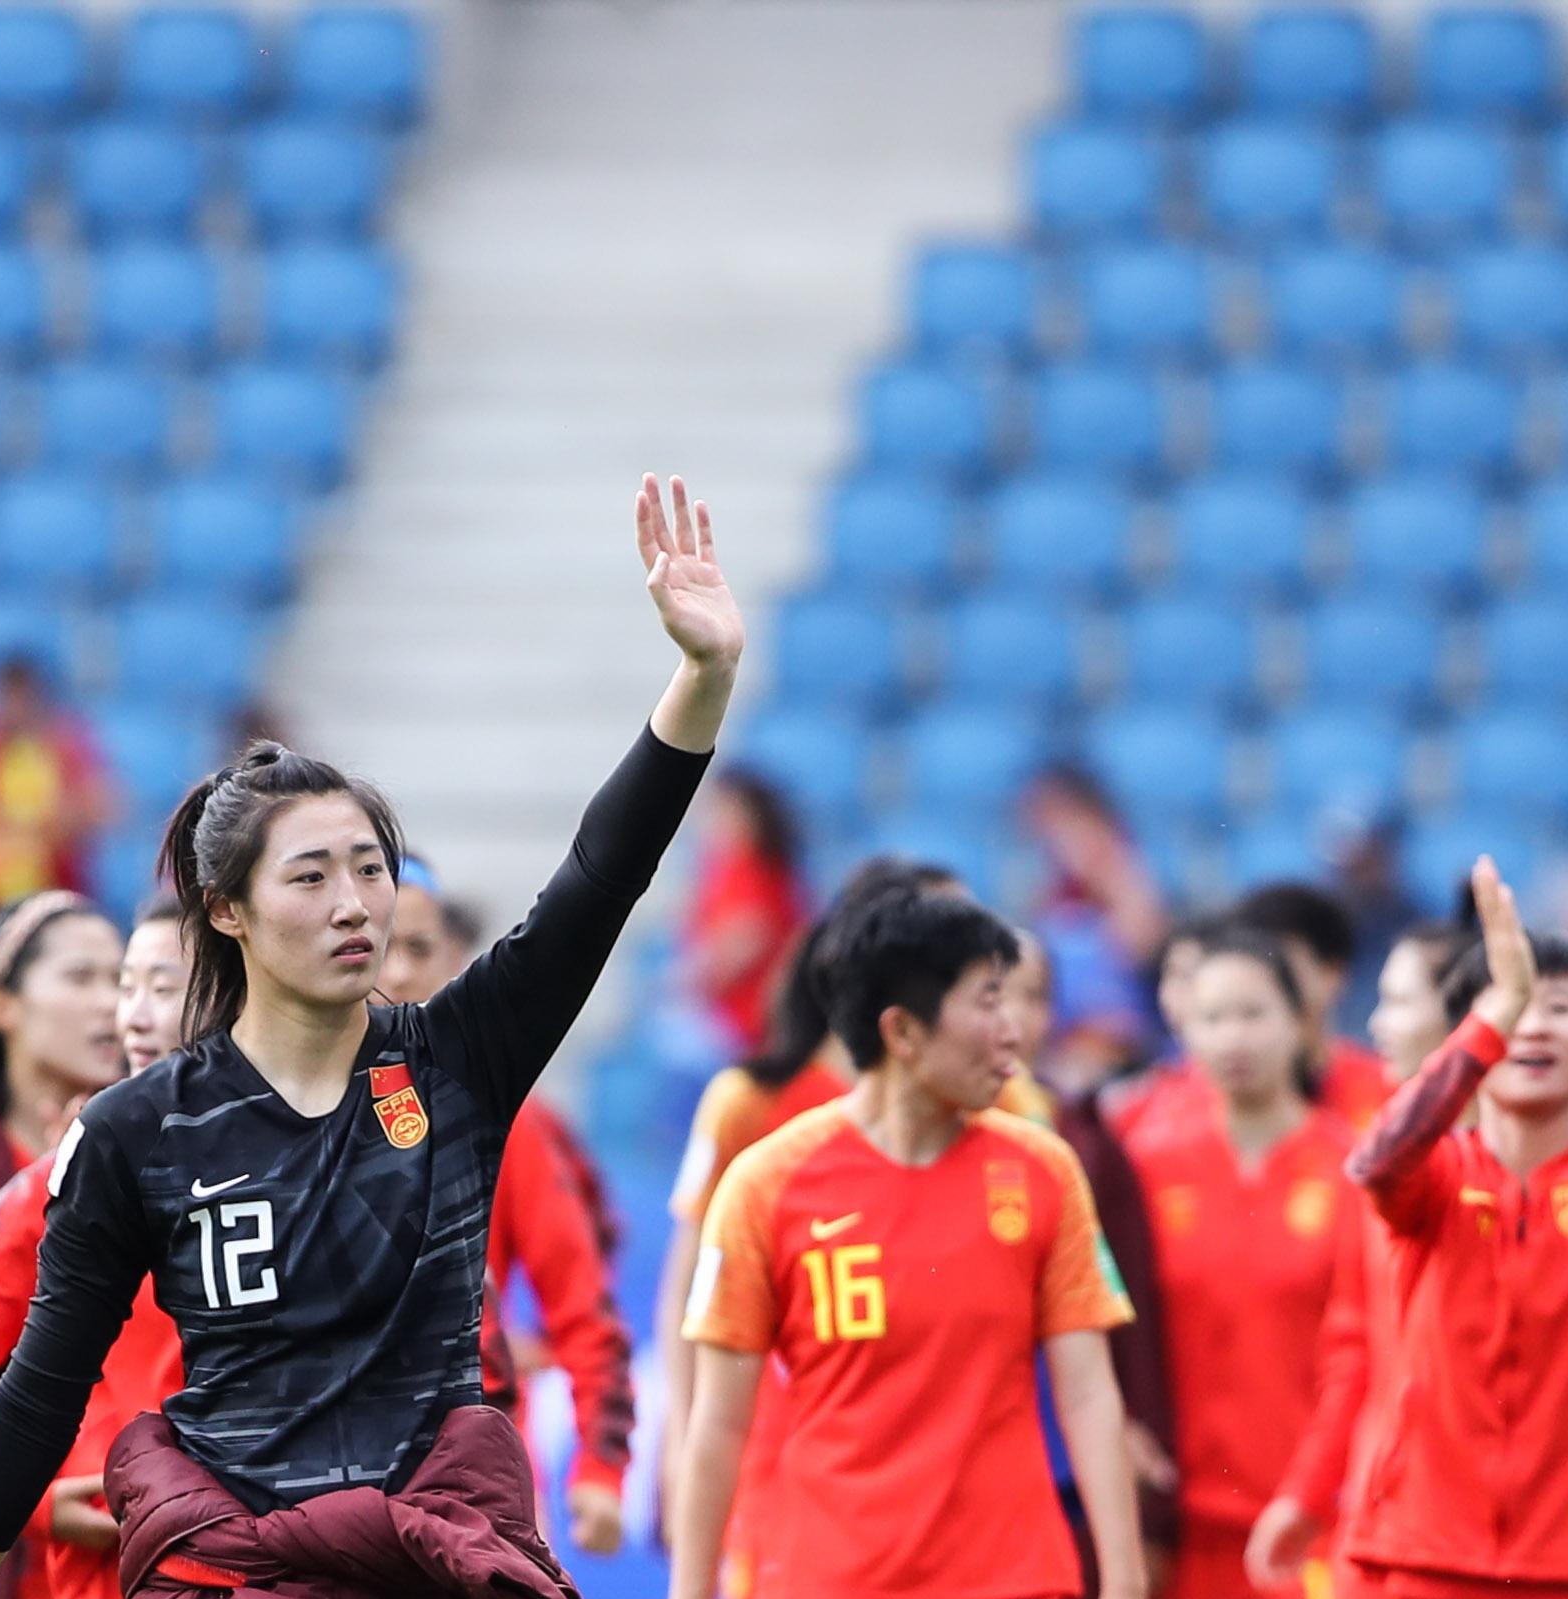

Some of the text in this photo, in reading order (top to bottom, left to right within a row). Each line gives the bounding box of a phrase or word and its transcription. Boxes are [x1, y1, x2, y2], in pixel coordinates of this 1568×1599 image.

[378, 1091, 414, 1116] CFA
[188, 1200, 278, 1308] 12
[801, 1244, 885, 1342] 16
